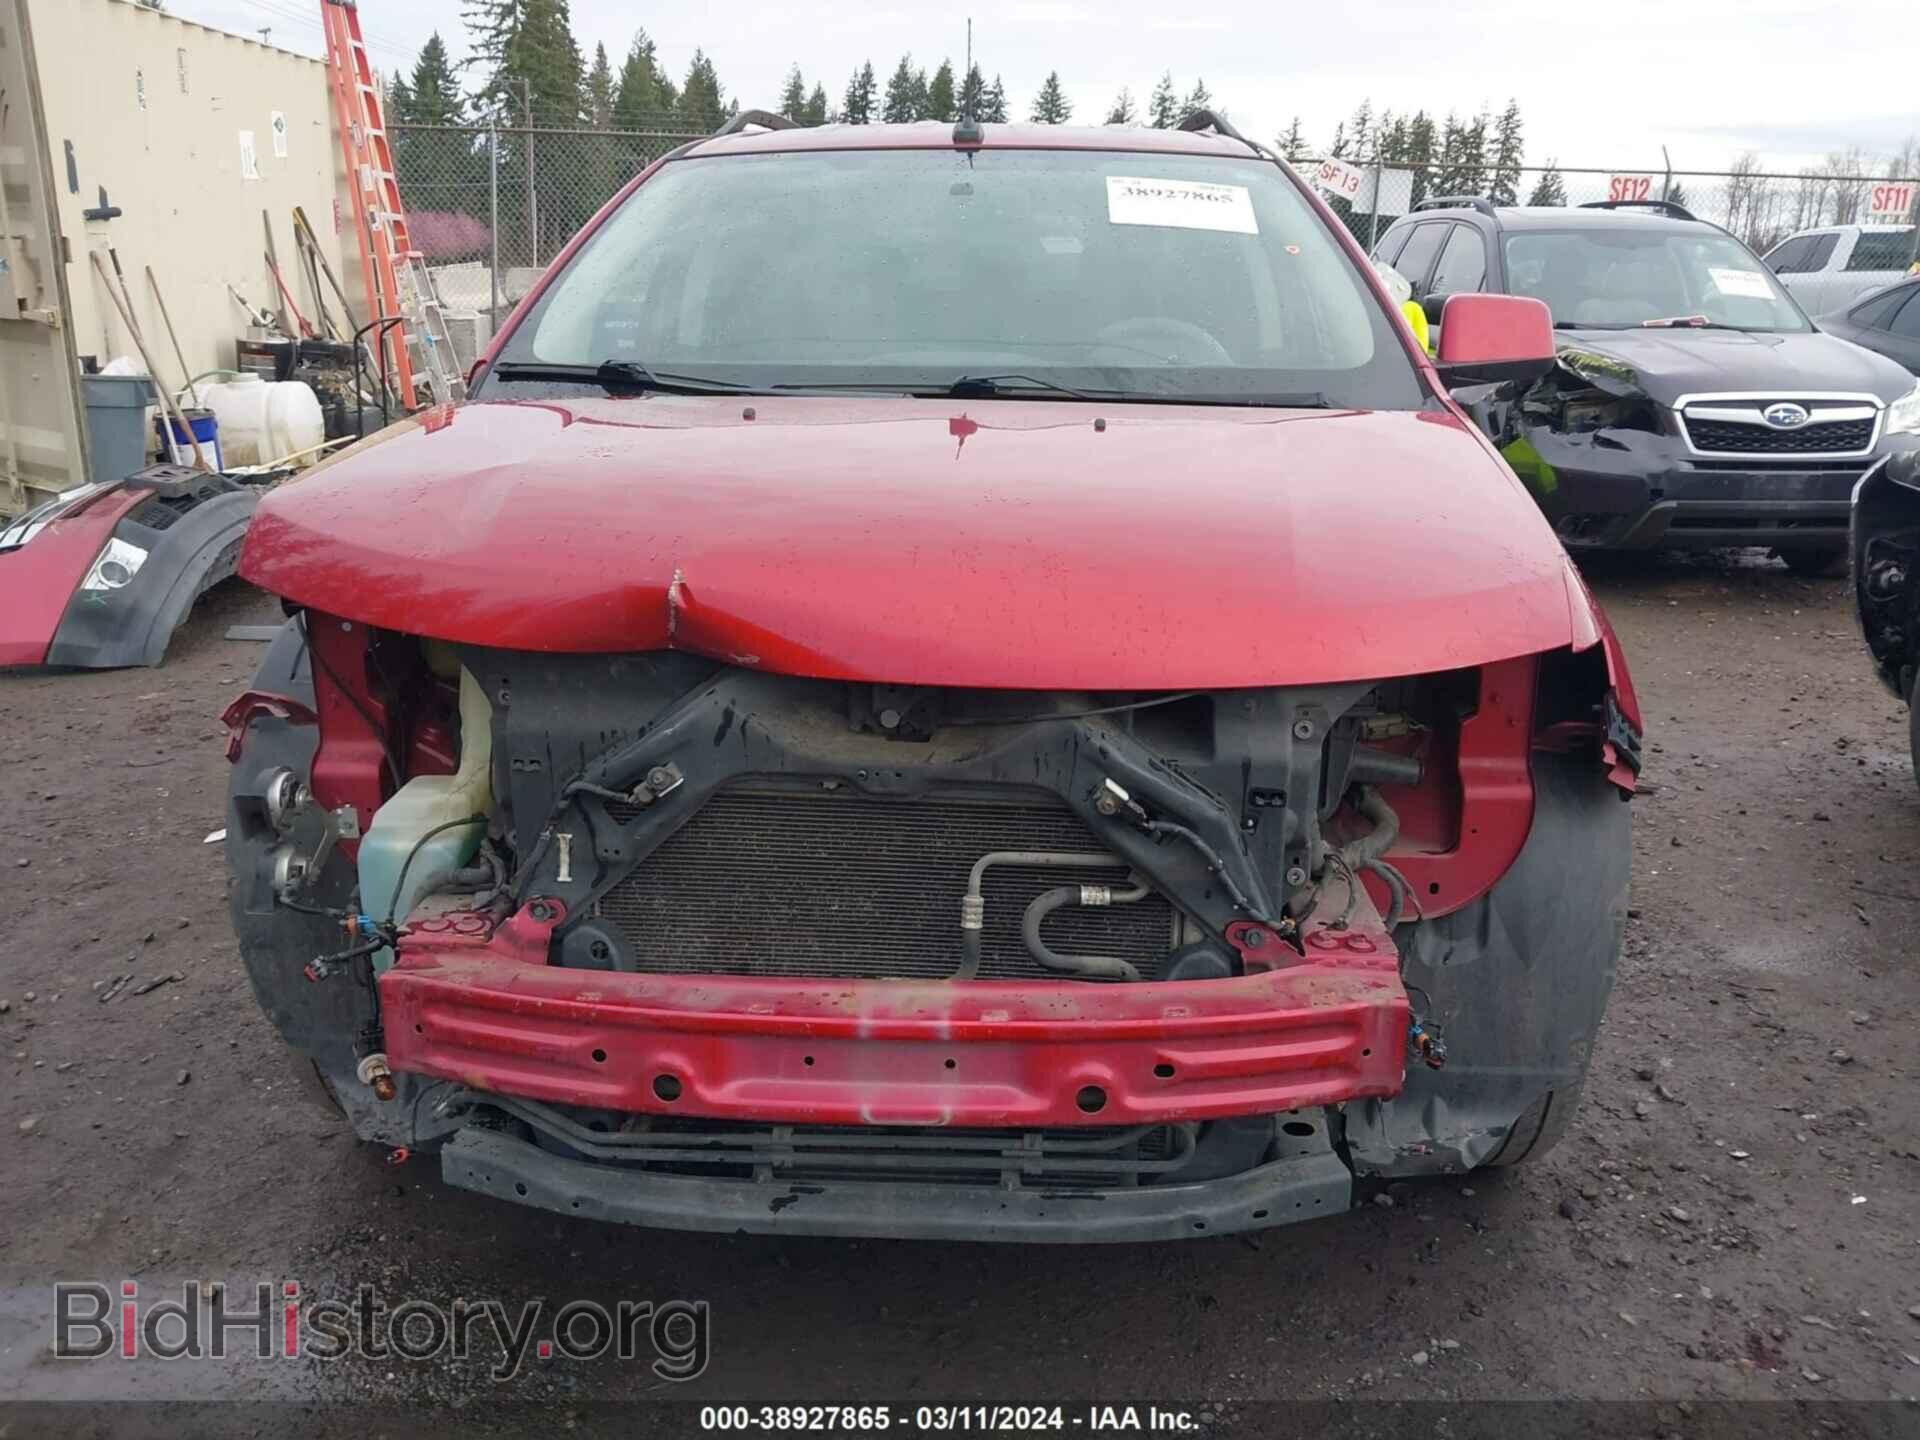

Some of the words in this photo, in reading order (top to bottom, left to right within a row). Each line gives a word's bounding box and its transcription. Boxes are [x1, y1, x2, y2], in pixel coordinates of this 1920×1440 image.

[1121, 186, 1234, 204] 38927865
[1608, 177, 1650, 201] SF12
[1872, 186, 1910, 211] SF11
